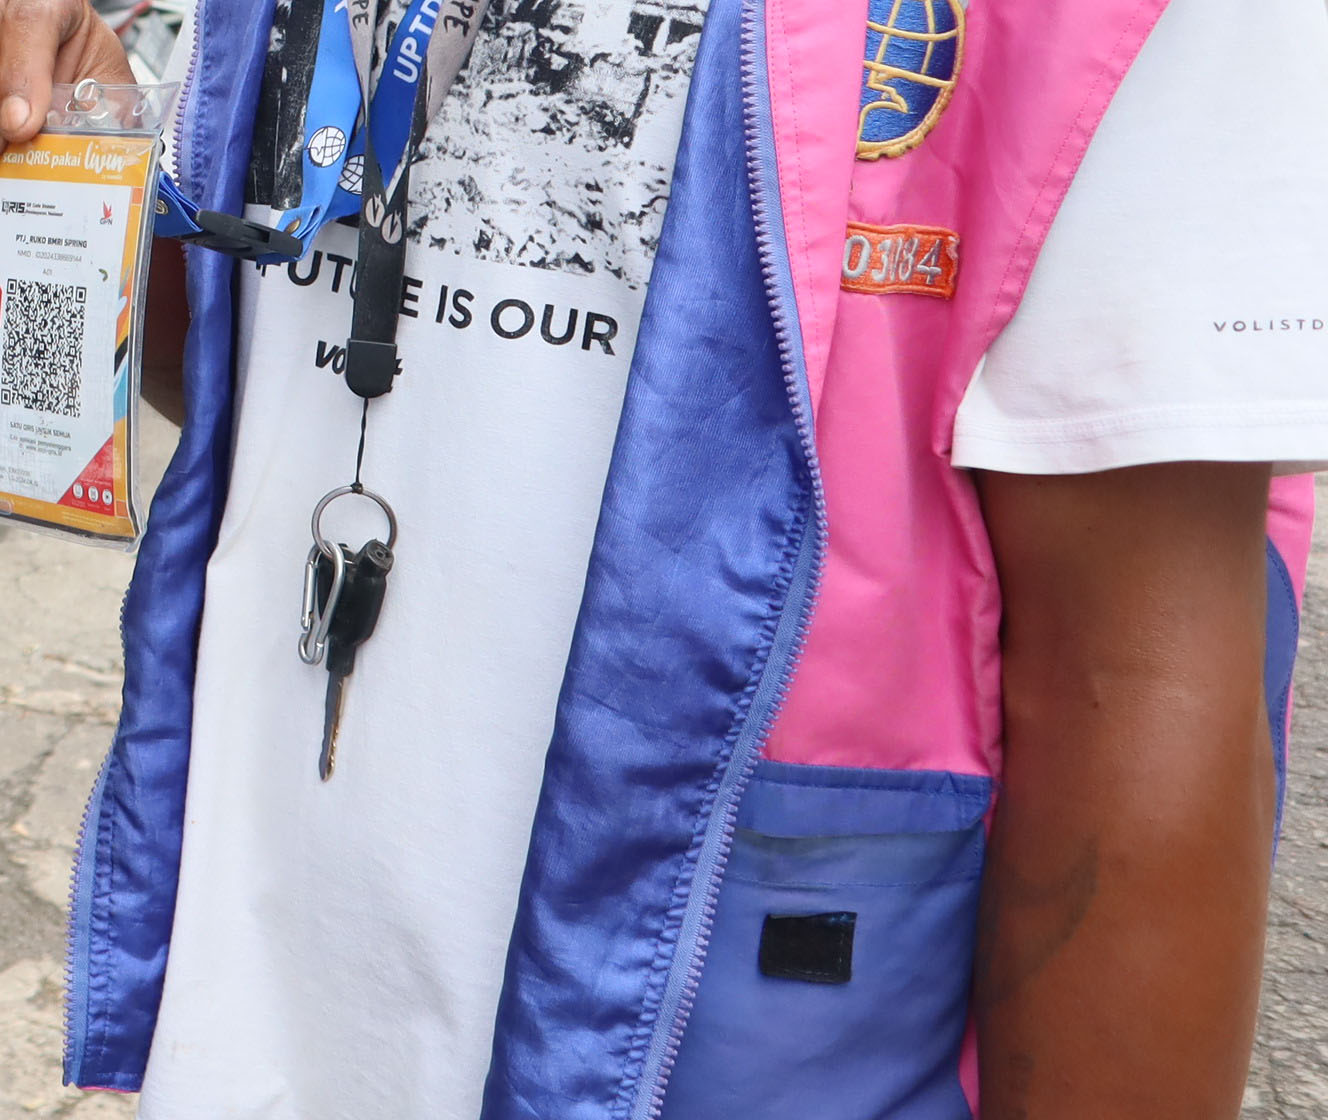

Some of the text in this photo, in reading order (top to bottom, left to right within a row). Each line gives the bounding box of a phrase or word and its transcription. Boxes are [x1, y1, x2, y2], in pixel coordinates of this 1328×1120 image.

[2, 151, 24, 164] scan
[25, 149, 50, 166] QRIS
[50, 151, 82, 168] pakai
[64, 239, 88, 249] SPRING
[435, 284, 475, 330] IS
[489, 298, 619, 357] OUR
